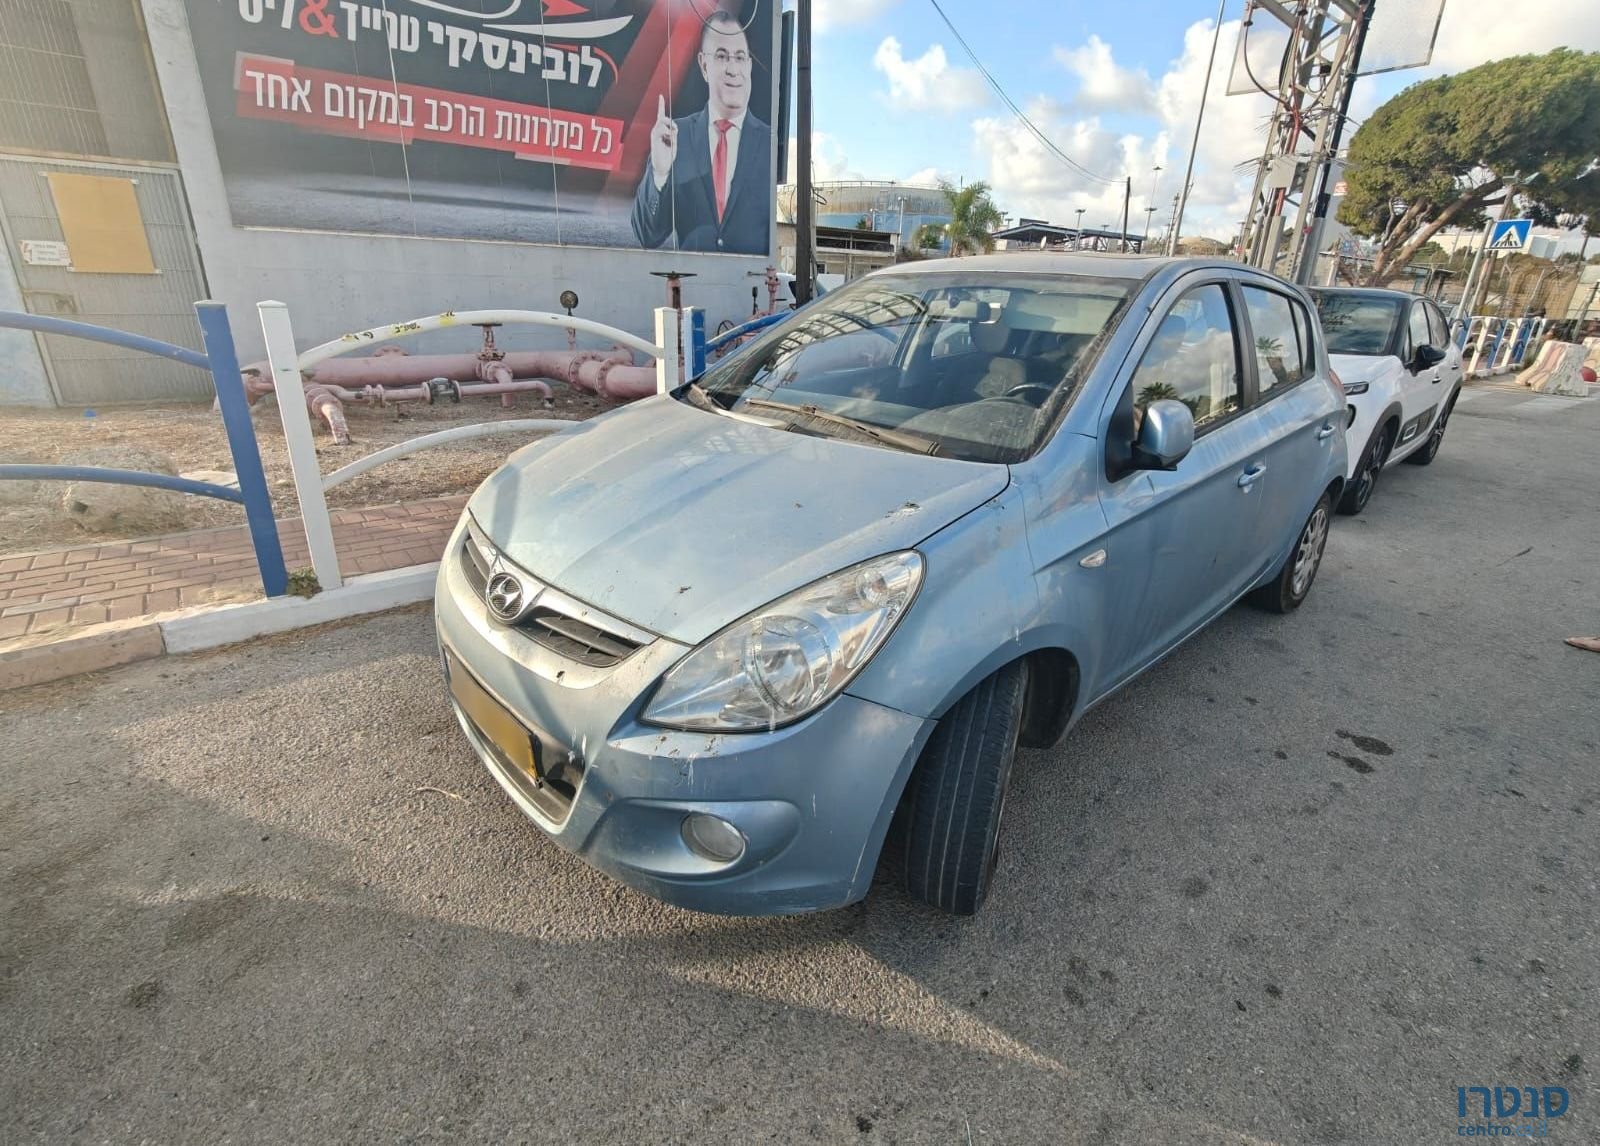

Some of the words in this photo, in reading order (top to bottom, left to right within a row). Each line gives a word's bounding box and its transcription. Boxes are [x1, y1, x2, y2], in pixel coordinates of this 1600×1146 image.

[428, 20, 602, 88] לובינסקי
[245, 70, 312, 113] אחד
[324, 82, 414, 129] במקום
[424, 98, 485, 137] הרכב
[493, 110, 584, 151] פתרונות
[591, 118, 612, 154] כל
